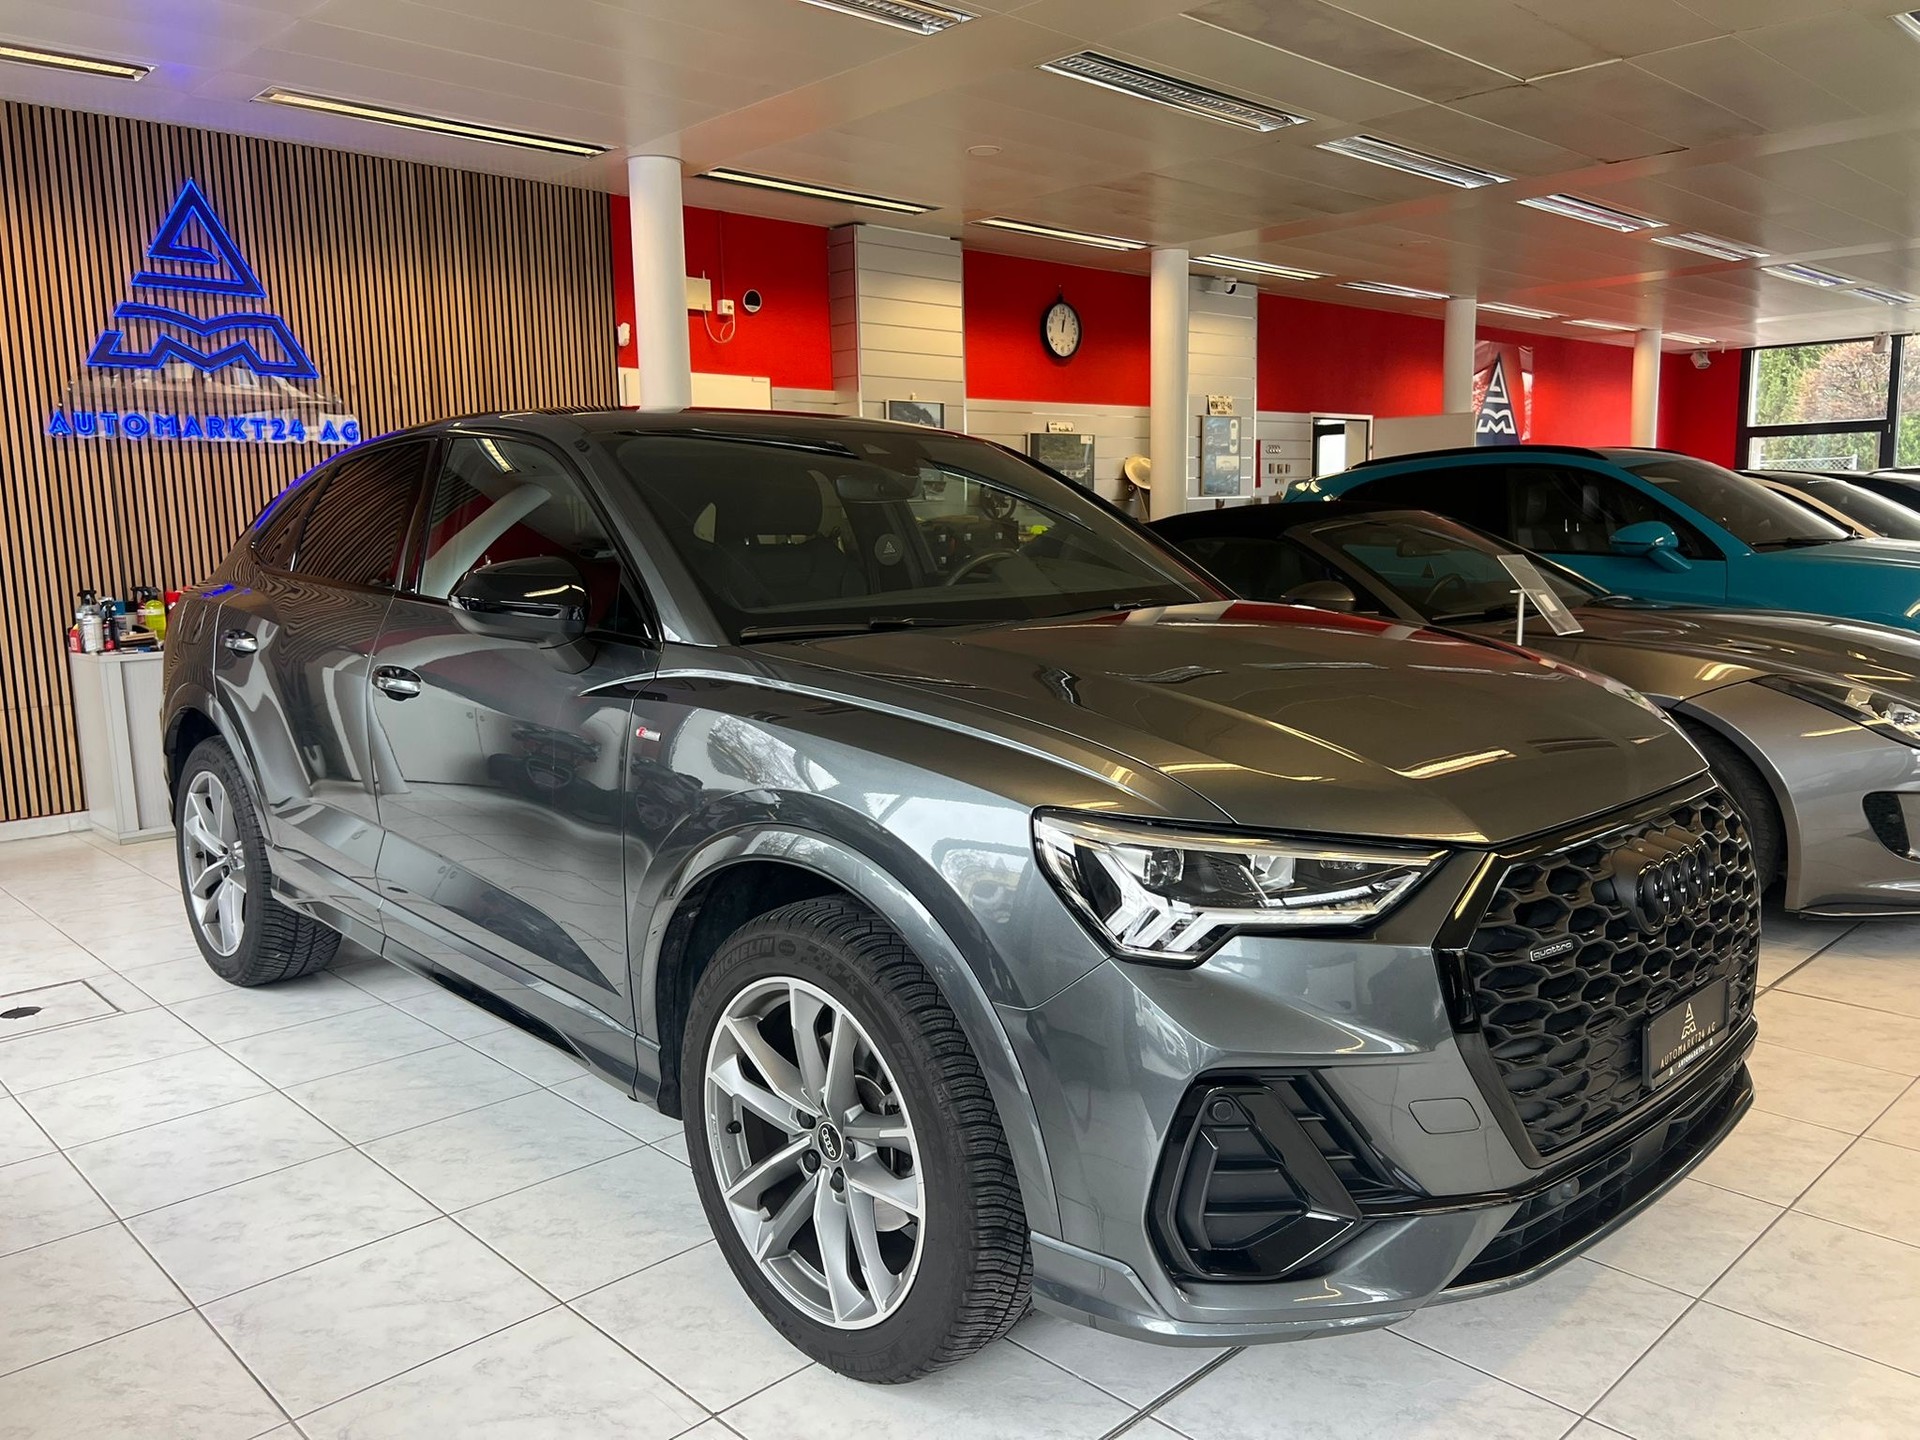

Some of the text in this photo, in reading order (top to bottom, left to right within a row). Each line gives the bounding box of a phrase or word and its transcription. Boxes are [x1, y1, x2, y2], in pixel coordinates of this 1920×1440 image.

[50, 411, 360, 442] AUTOMARKT24 AG
[709, 937, 774, 987] MICHELIN
[1533, 941, 1572, 959] quattro
[1660, 1029, 1706, 1069] AUTOMARKT24
